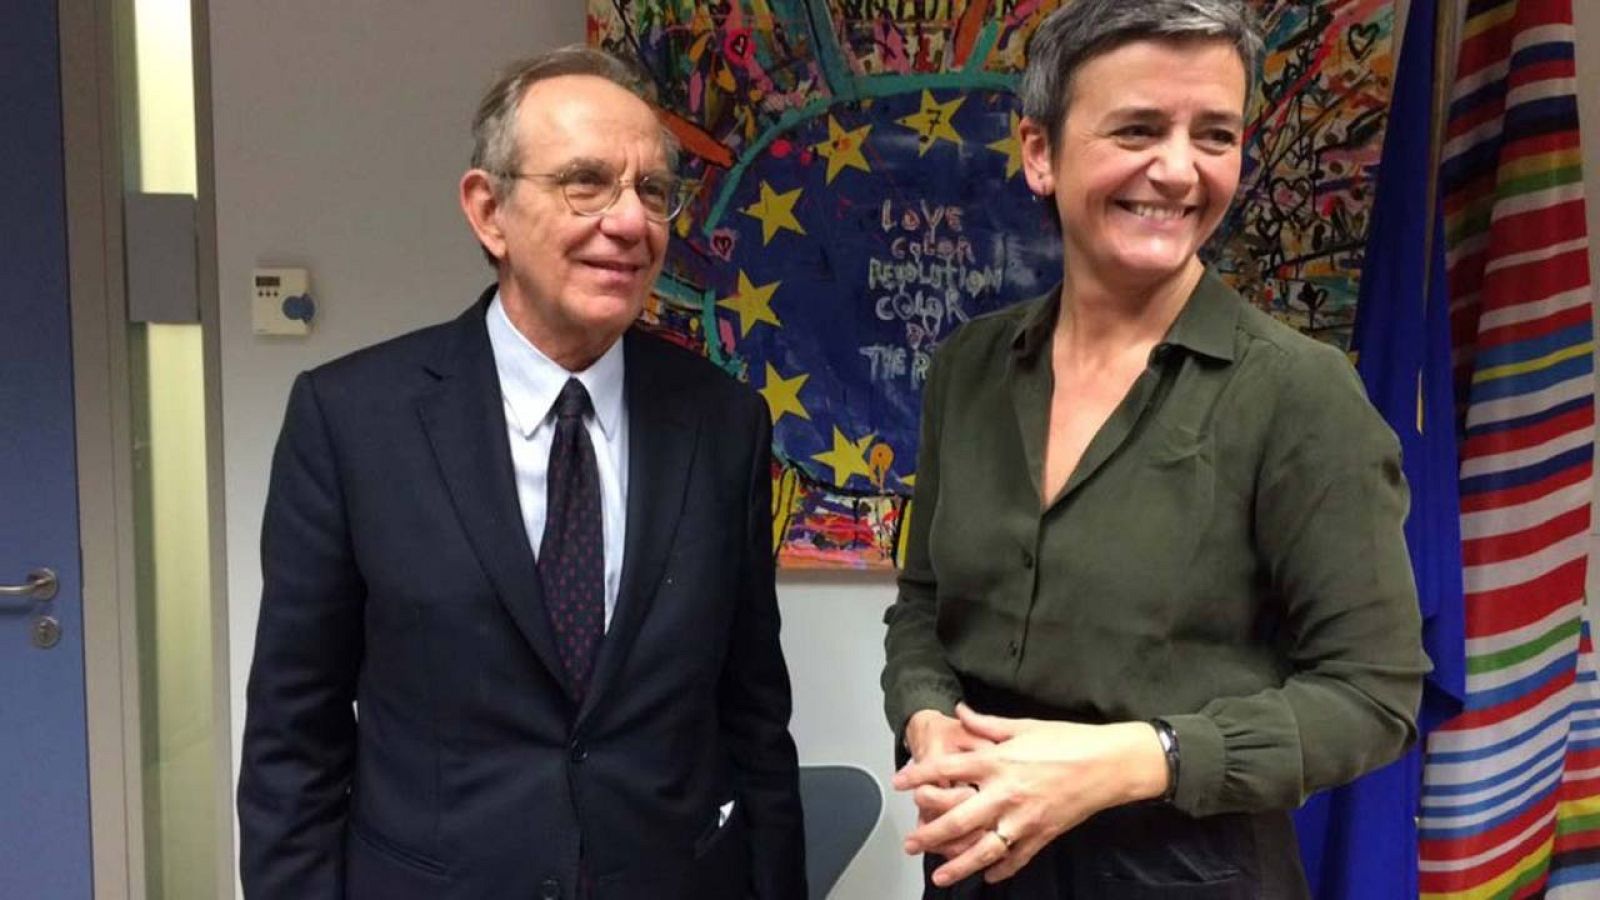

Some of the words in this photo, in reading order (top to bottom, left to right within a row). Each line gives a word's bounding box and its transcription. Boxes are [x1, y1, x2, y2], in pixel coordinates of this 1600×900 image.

[869, 258, 1003, 297] REVOLUTION
[875, 290, 970, 323] COLOR
[859, 344, 906, 381] THE
